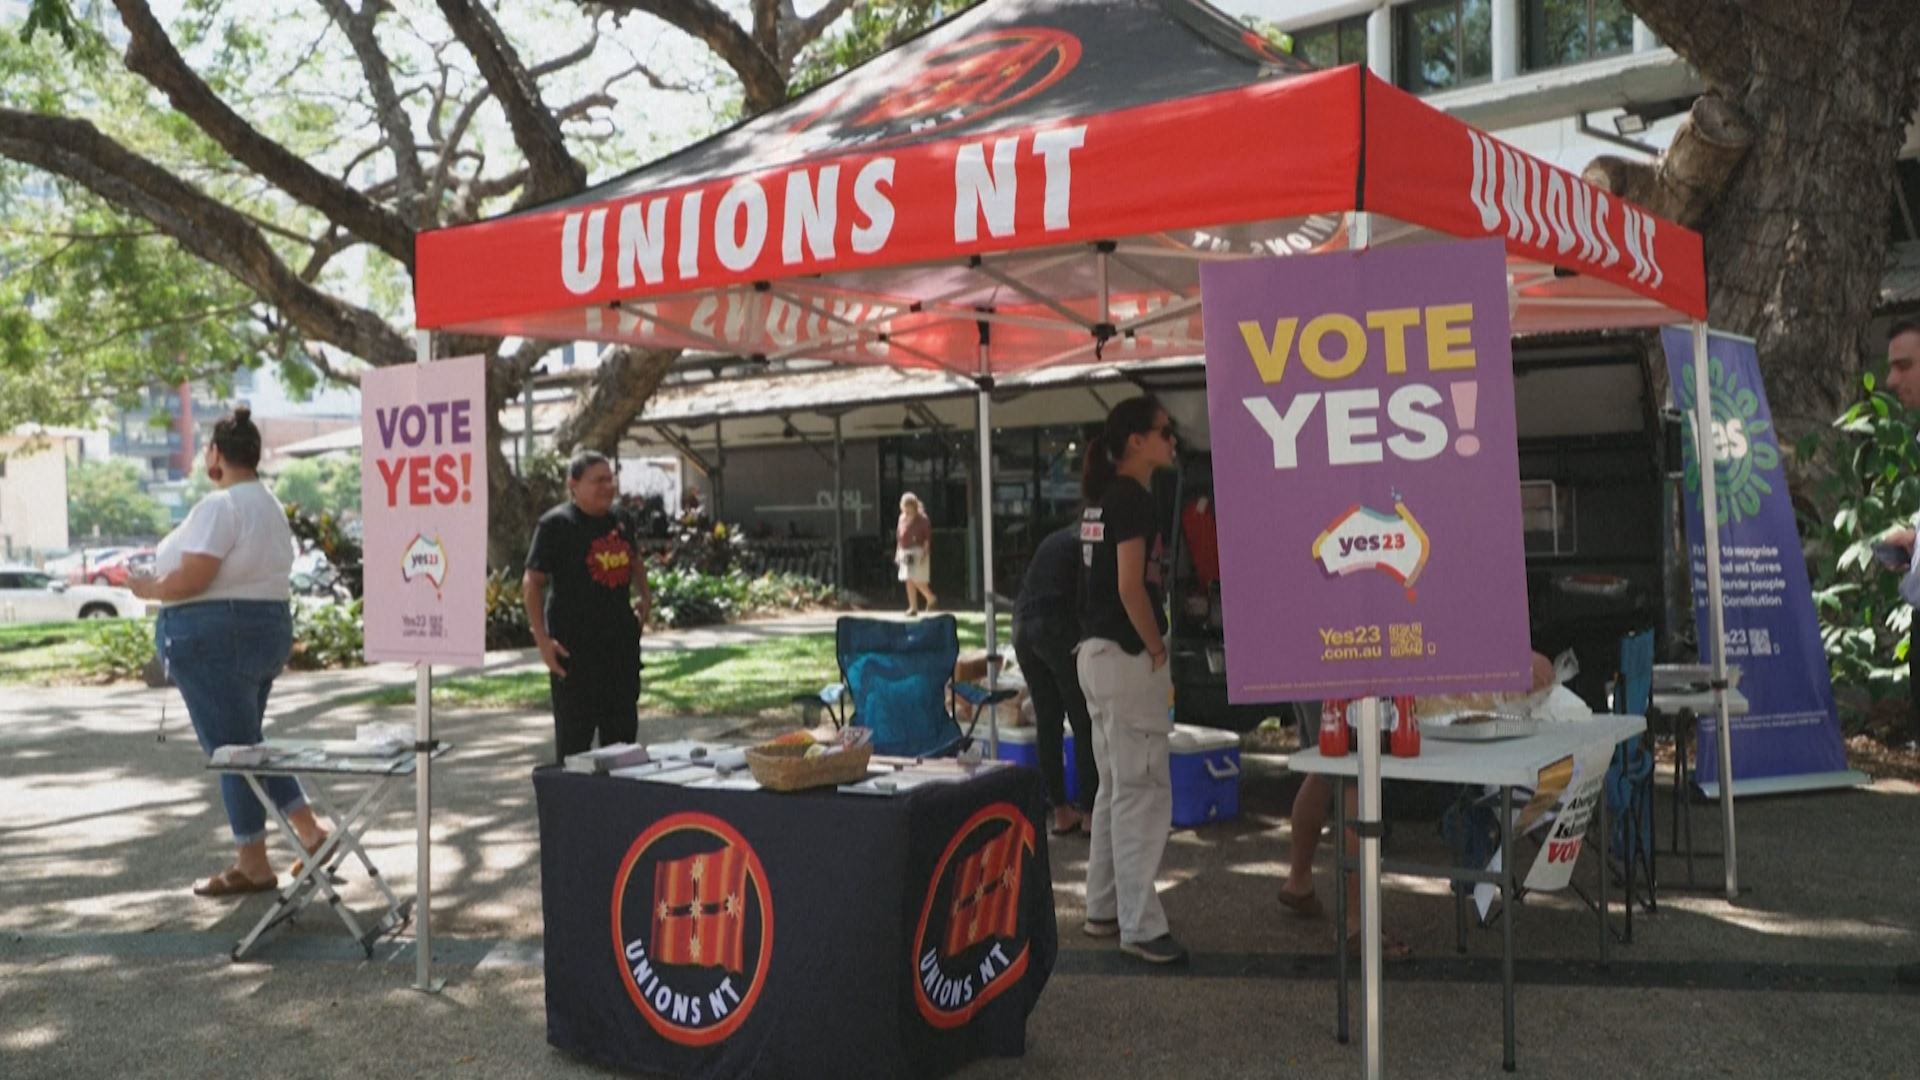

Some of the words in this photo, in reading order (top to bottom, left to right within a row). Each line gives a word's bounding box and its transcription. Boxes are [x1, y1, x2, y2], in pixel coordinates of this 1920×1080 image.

[561, 157, 896, 295] UNIONS
[954, 125, 1088, 243] NT
[1467, 128, 1620, 268] UNIONS
[1623, 203, 1663, 289] NT
[1237, 303, 1477, 384] VOTE
[375, 399, 472, 449] VOTE
[1241, 381, 1480, 469] YES!
[375, 452, 472, 508] YES!
[1338, 533, 1406, 557] yes23
[1319, 625, 1381, 646] Yes23
[1319, 644, 1382, 661] .com.au
[625, 938, 701, 1025] UNIONS
[709, 976, 741, 1020] NT
[919, 947, 973, 1006] UNIONS
[979, 942, 1010, 983] NT
